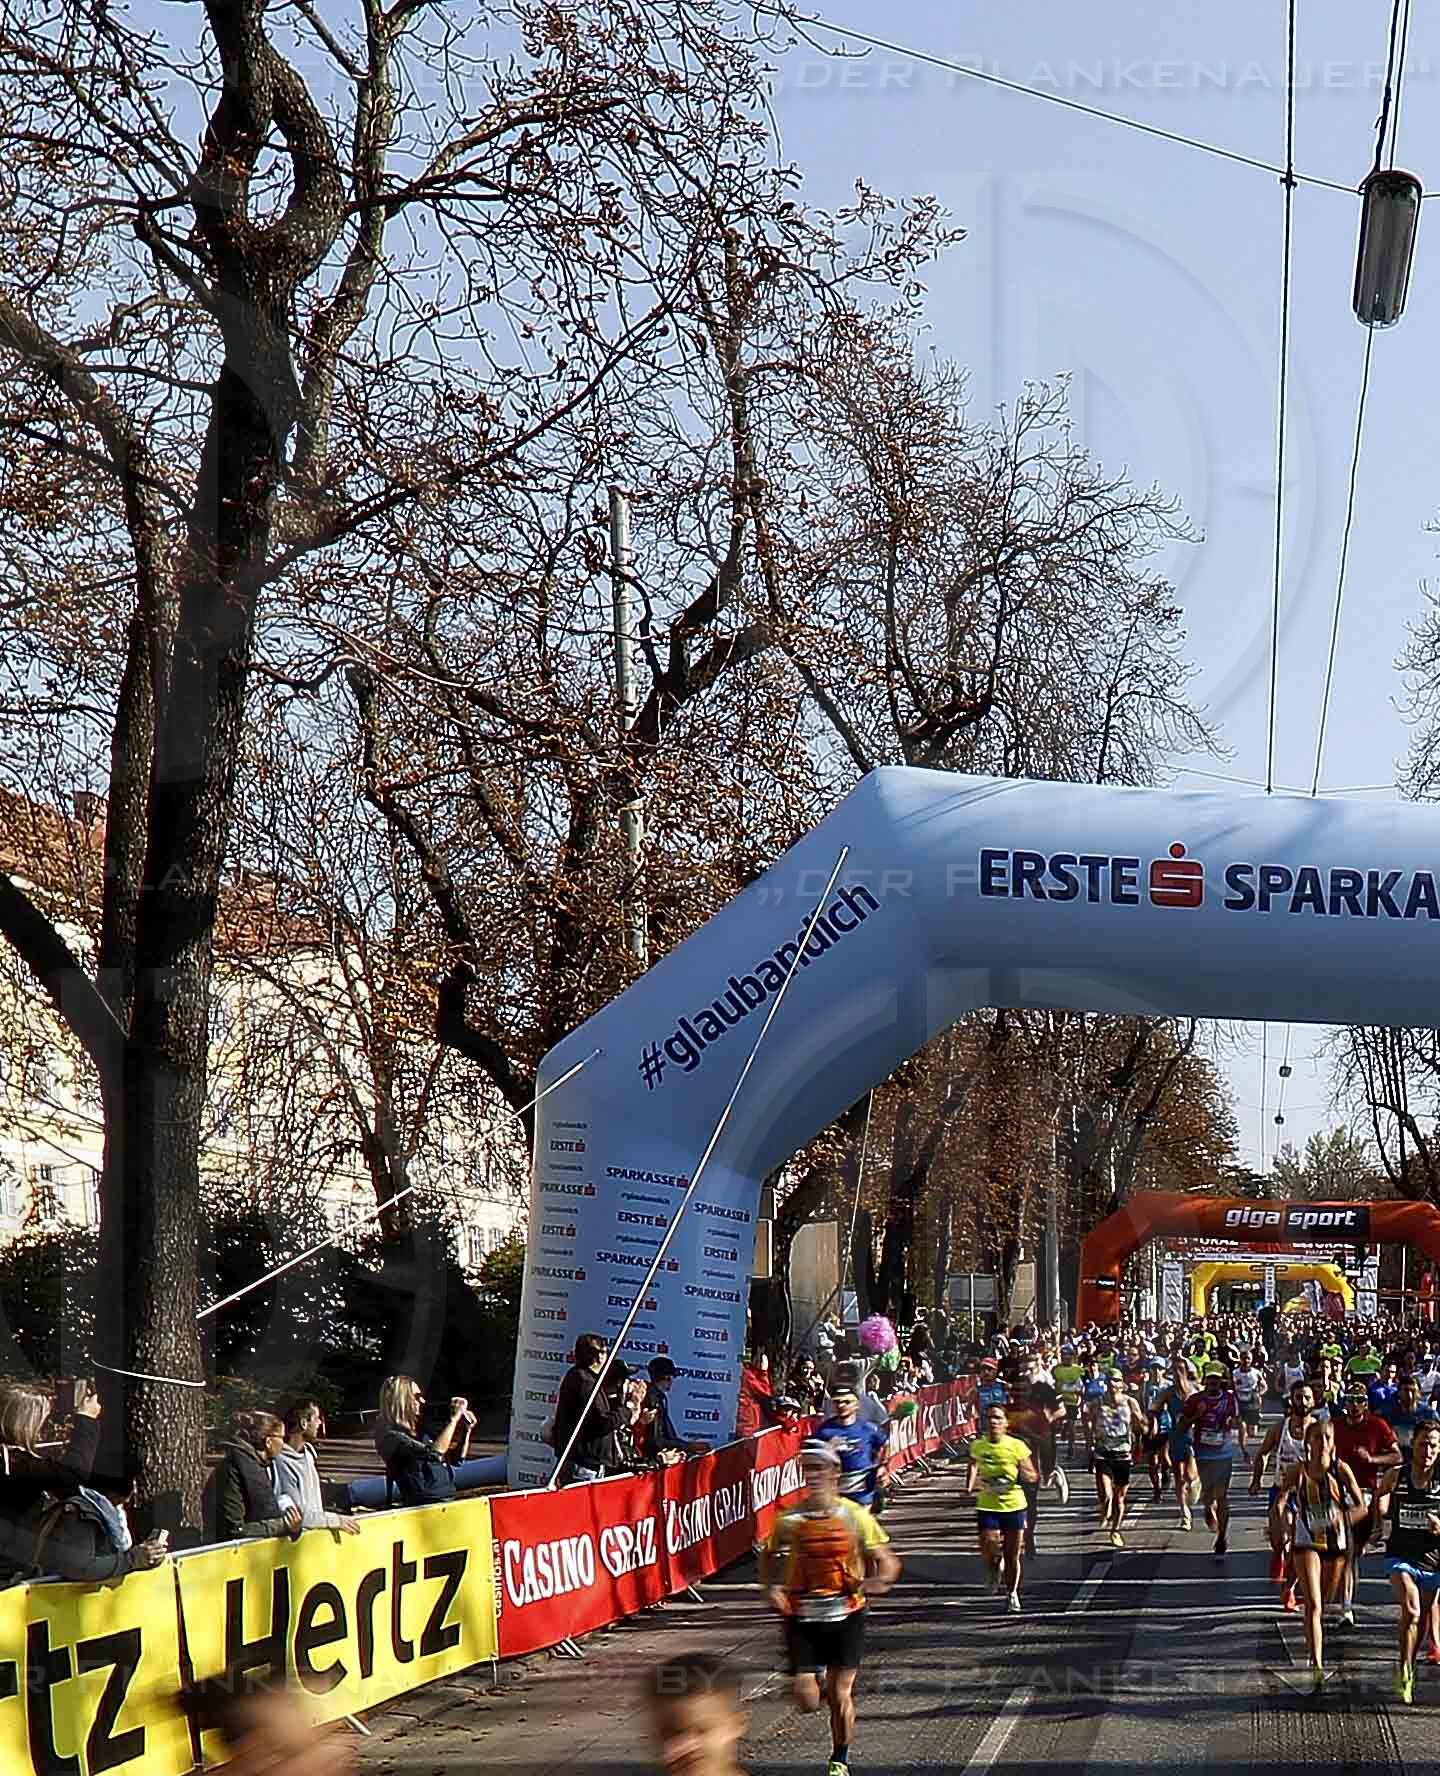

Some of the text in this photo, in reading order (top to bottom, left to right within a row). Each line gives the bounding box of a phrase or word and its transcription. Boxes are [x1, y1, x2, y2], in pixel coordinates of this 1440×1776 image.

[981, 849, 1140, 905] ERSTE
[606, 1167, 676, 1187] SPARKASSE
[617, 1211, 654, 1226] ERSTE
[1225, 1206, 1358, 1229] giga sport
[666, 1494, 711, 1555] CASINO
[503, 1516, 657, 1608] CASINO GRAZ
[226, 1540, 467, 1708] Hertz
